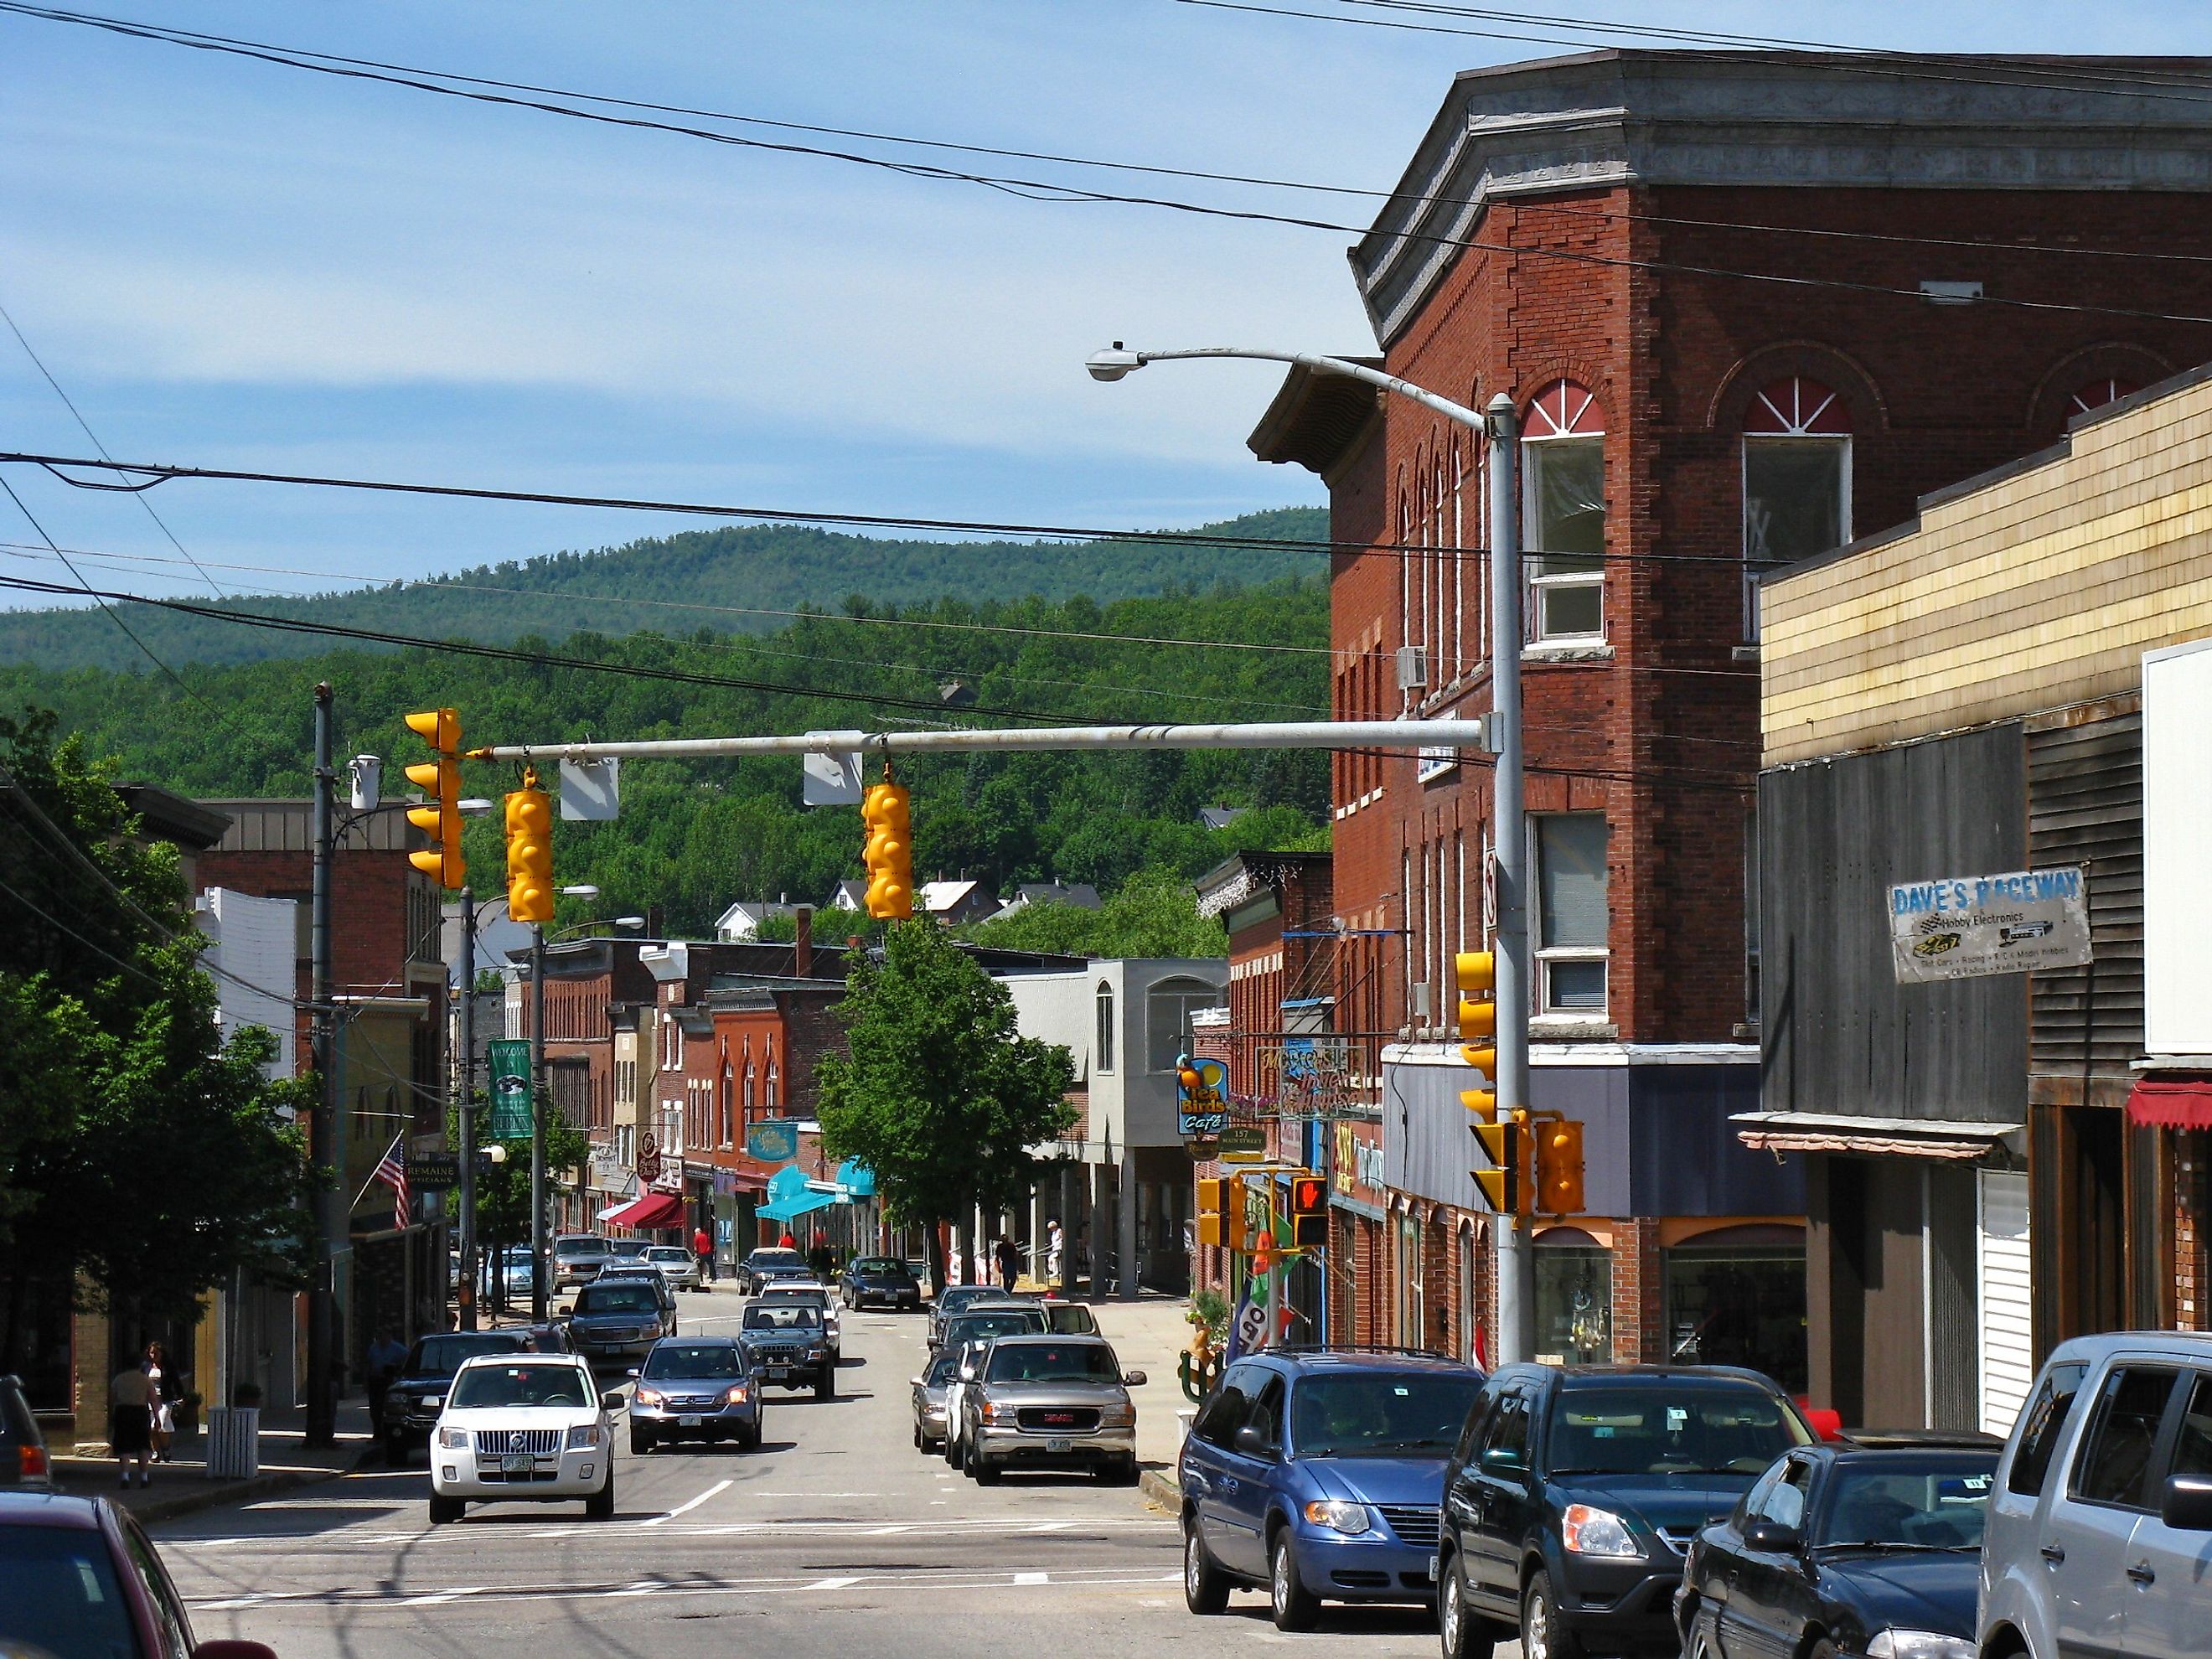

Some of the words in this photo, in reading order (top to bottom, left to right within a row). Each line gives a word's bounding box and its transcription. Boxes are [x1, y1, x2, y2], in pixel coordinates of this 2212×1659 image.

[1894, 880, 1970, 914] DAVE'S
[1977, 871, 2078, 906] RACEWAY
[1942, 917, 1971, 928] Hobby
[1974, 912, 2024, 925] Electronics
[492, 1047, 528, 1057] WELCOME
[1189, 1088, 1221, 1101] Tea
[1181, 1099, 1227, 1114] Birds
[1184, 1114, 1222, 1131] Café
[1235, 1129, 1248, 1138] 157
[407, 1166, 454, 1176] REMAINE
